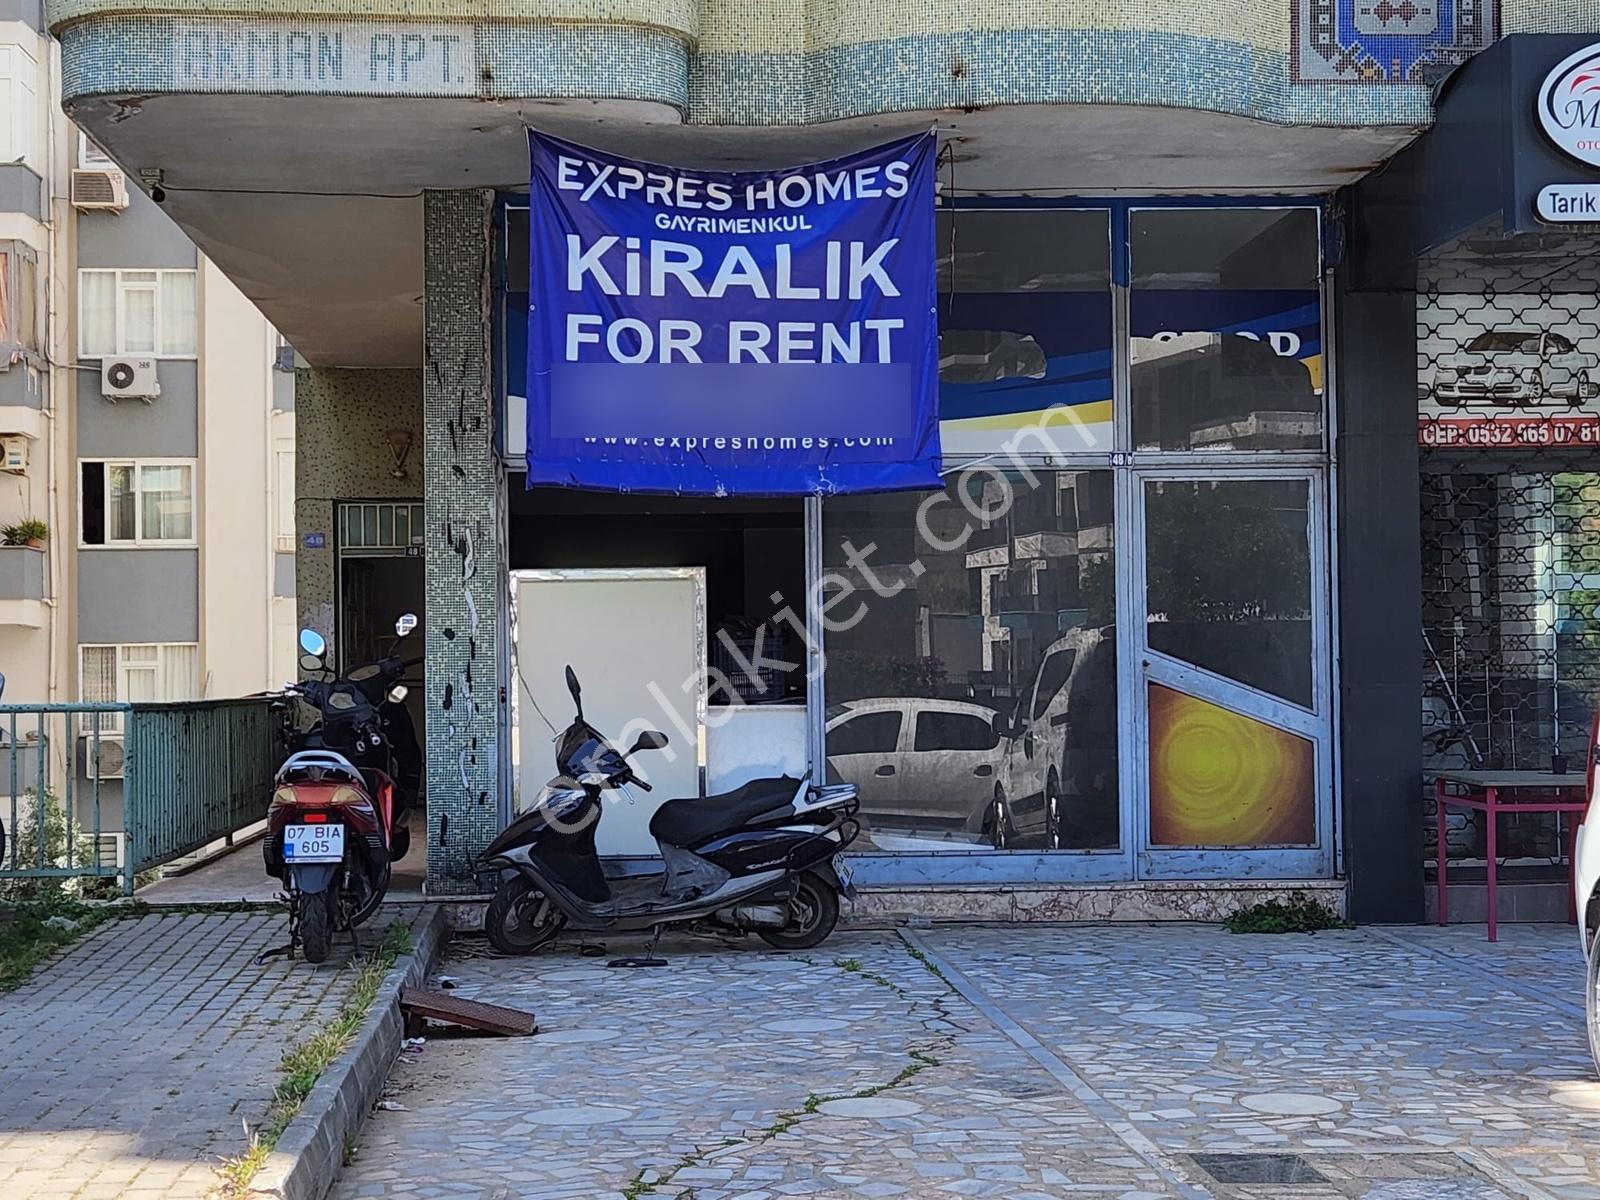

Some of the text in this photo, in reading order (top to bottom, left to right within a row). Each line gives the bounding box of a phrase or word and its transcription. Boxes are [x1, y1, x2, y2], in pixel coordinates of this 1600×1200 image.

[184, 31, 464, 83] AKMAN APT.
[557, 155, 910, 212] EXPRES HOMES
[1549, 193, 1596, 213] Tarık
[655, 213, 812, 234] GAYRIMENKUL
[565, 314, 904, 364] FOR RENT
[287, 826, 341, 839] 07 BIA
[302, 840, 329, 853] 605
